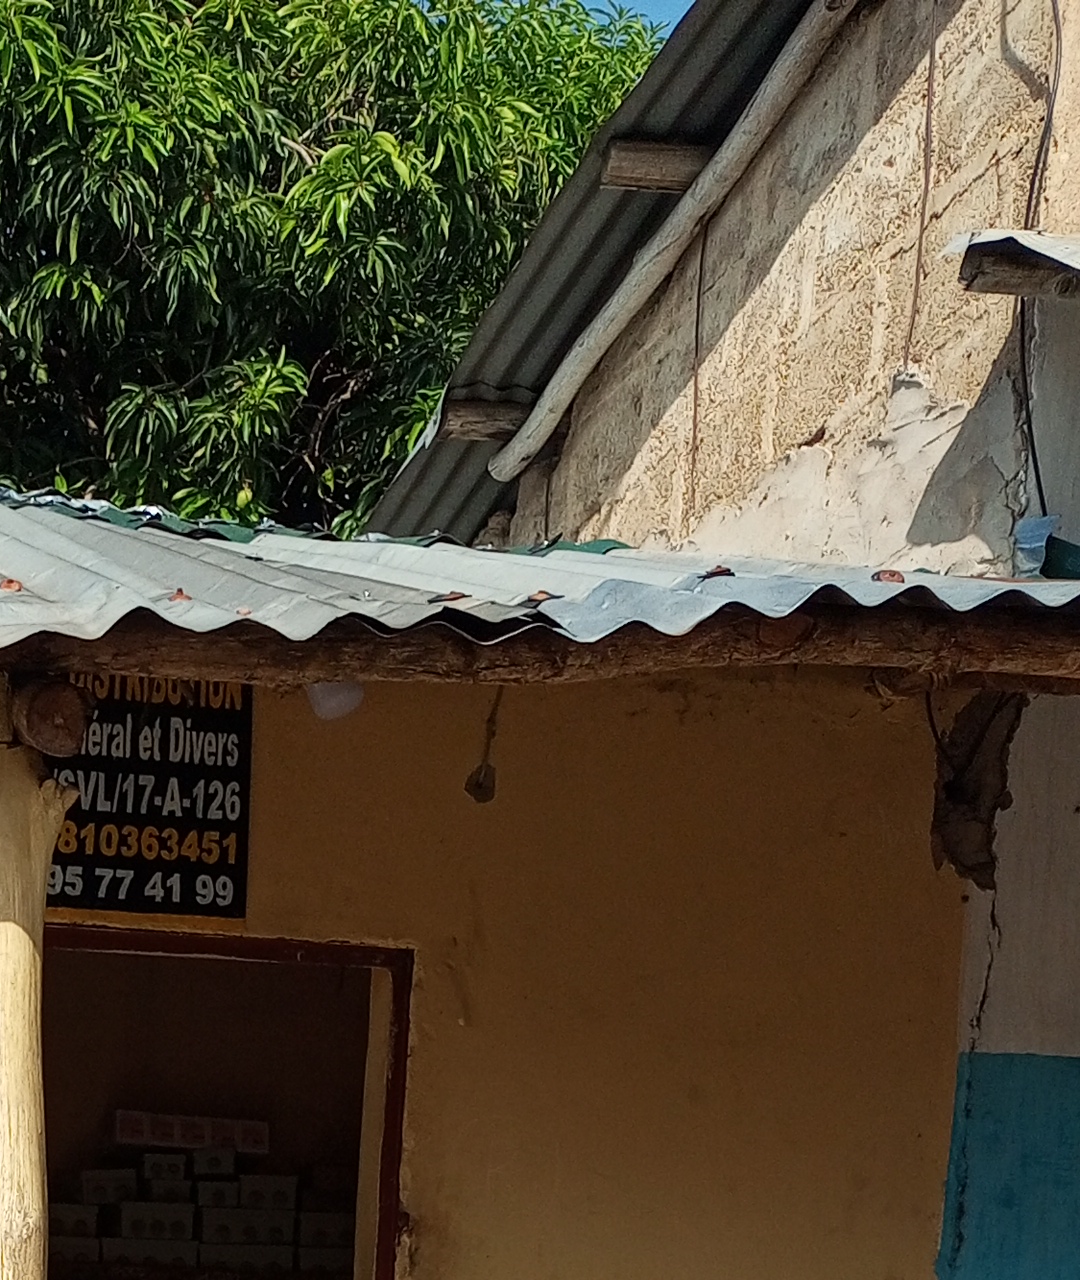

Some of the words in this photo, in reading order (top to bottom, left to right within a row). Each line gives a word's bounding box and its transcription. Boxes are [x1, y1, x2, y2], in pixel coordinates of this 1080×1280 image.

[139, 717, 162, 762] et
[168, 716, 240, 767] Divers
[47, 864, 83, 896] 95
[95, 868, 134, 901] 77
[144, 871, 182, 903] 41
[195, 875, 234, 906] 99
